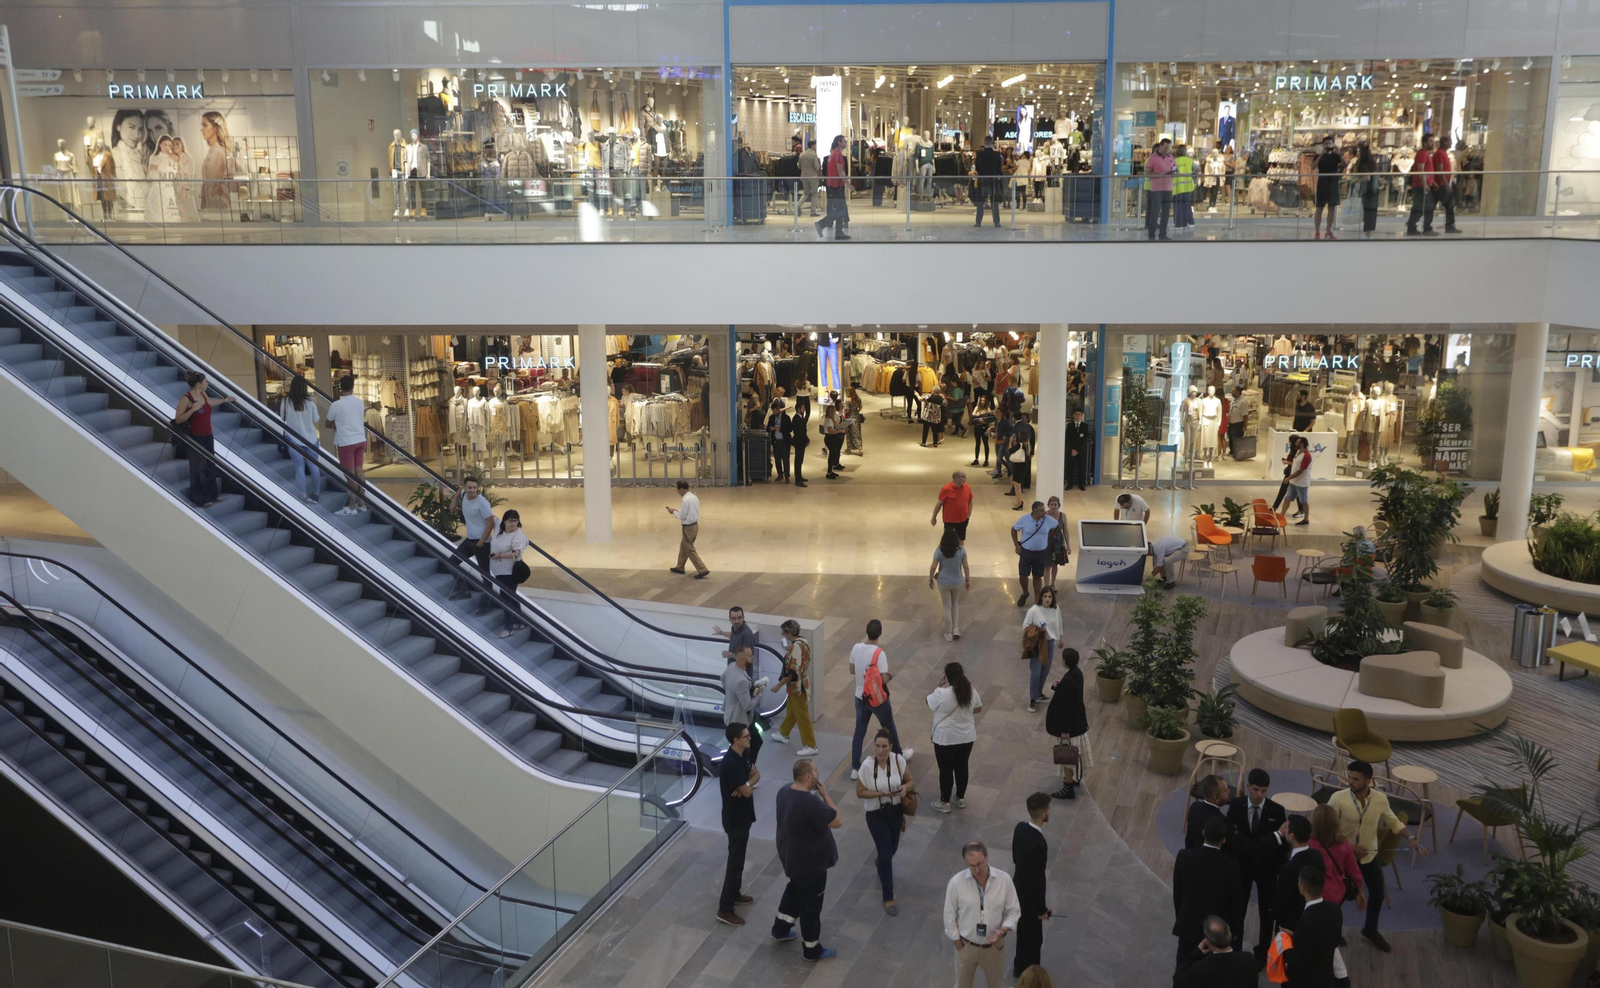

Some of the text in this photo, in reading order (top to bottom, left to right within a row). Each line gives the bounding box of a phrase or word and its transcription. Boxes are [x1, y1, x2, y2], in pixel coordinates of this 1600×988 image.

[1275, 75, 1373, 90] PRIMARK
[109, 84, 204, 99] PRIMARK
[473, 83, 567, 98] PRIMARK
[1301, 107, 1361, 126] BABY
[484, 356, 576, 370] PRIMARK
[1264, 355, 1359, 368] PRIMARK
[1566, 354, 1600, 368] PRI
[1435, 451, 1467, 461] NADIE
